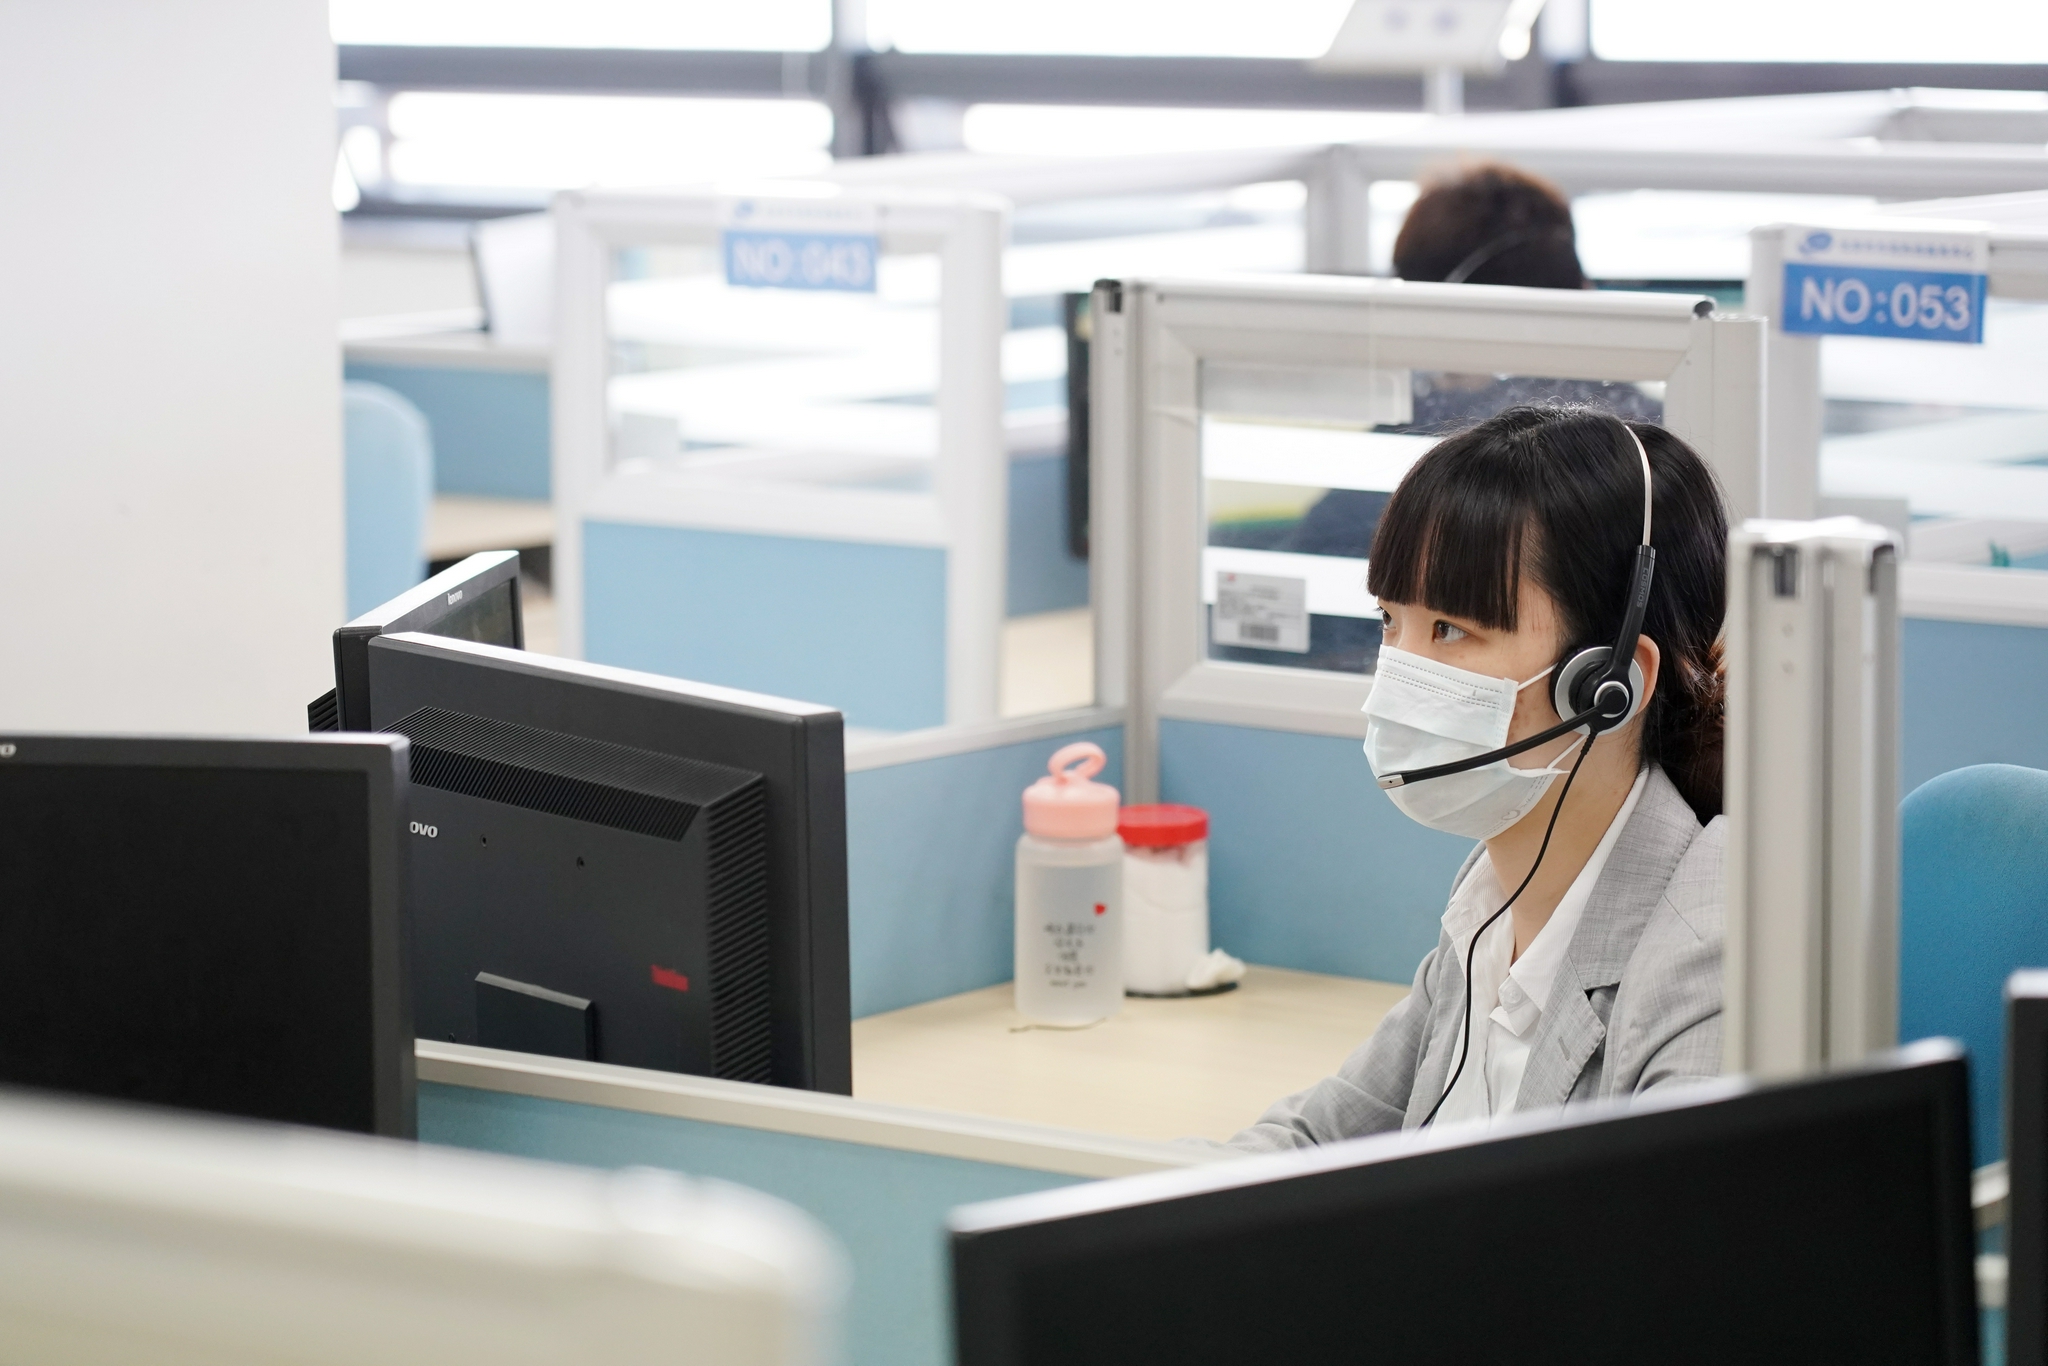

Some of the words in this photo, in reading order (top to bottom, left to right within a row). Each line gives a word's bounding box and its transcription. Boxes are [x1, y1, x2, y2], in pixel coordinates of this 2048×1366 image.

[1800, 276, 1970, 331] NO:053
[1636, 567, 1649, 608] COSMOS
[409, 821, 438, 838] ovo
